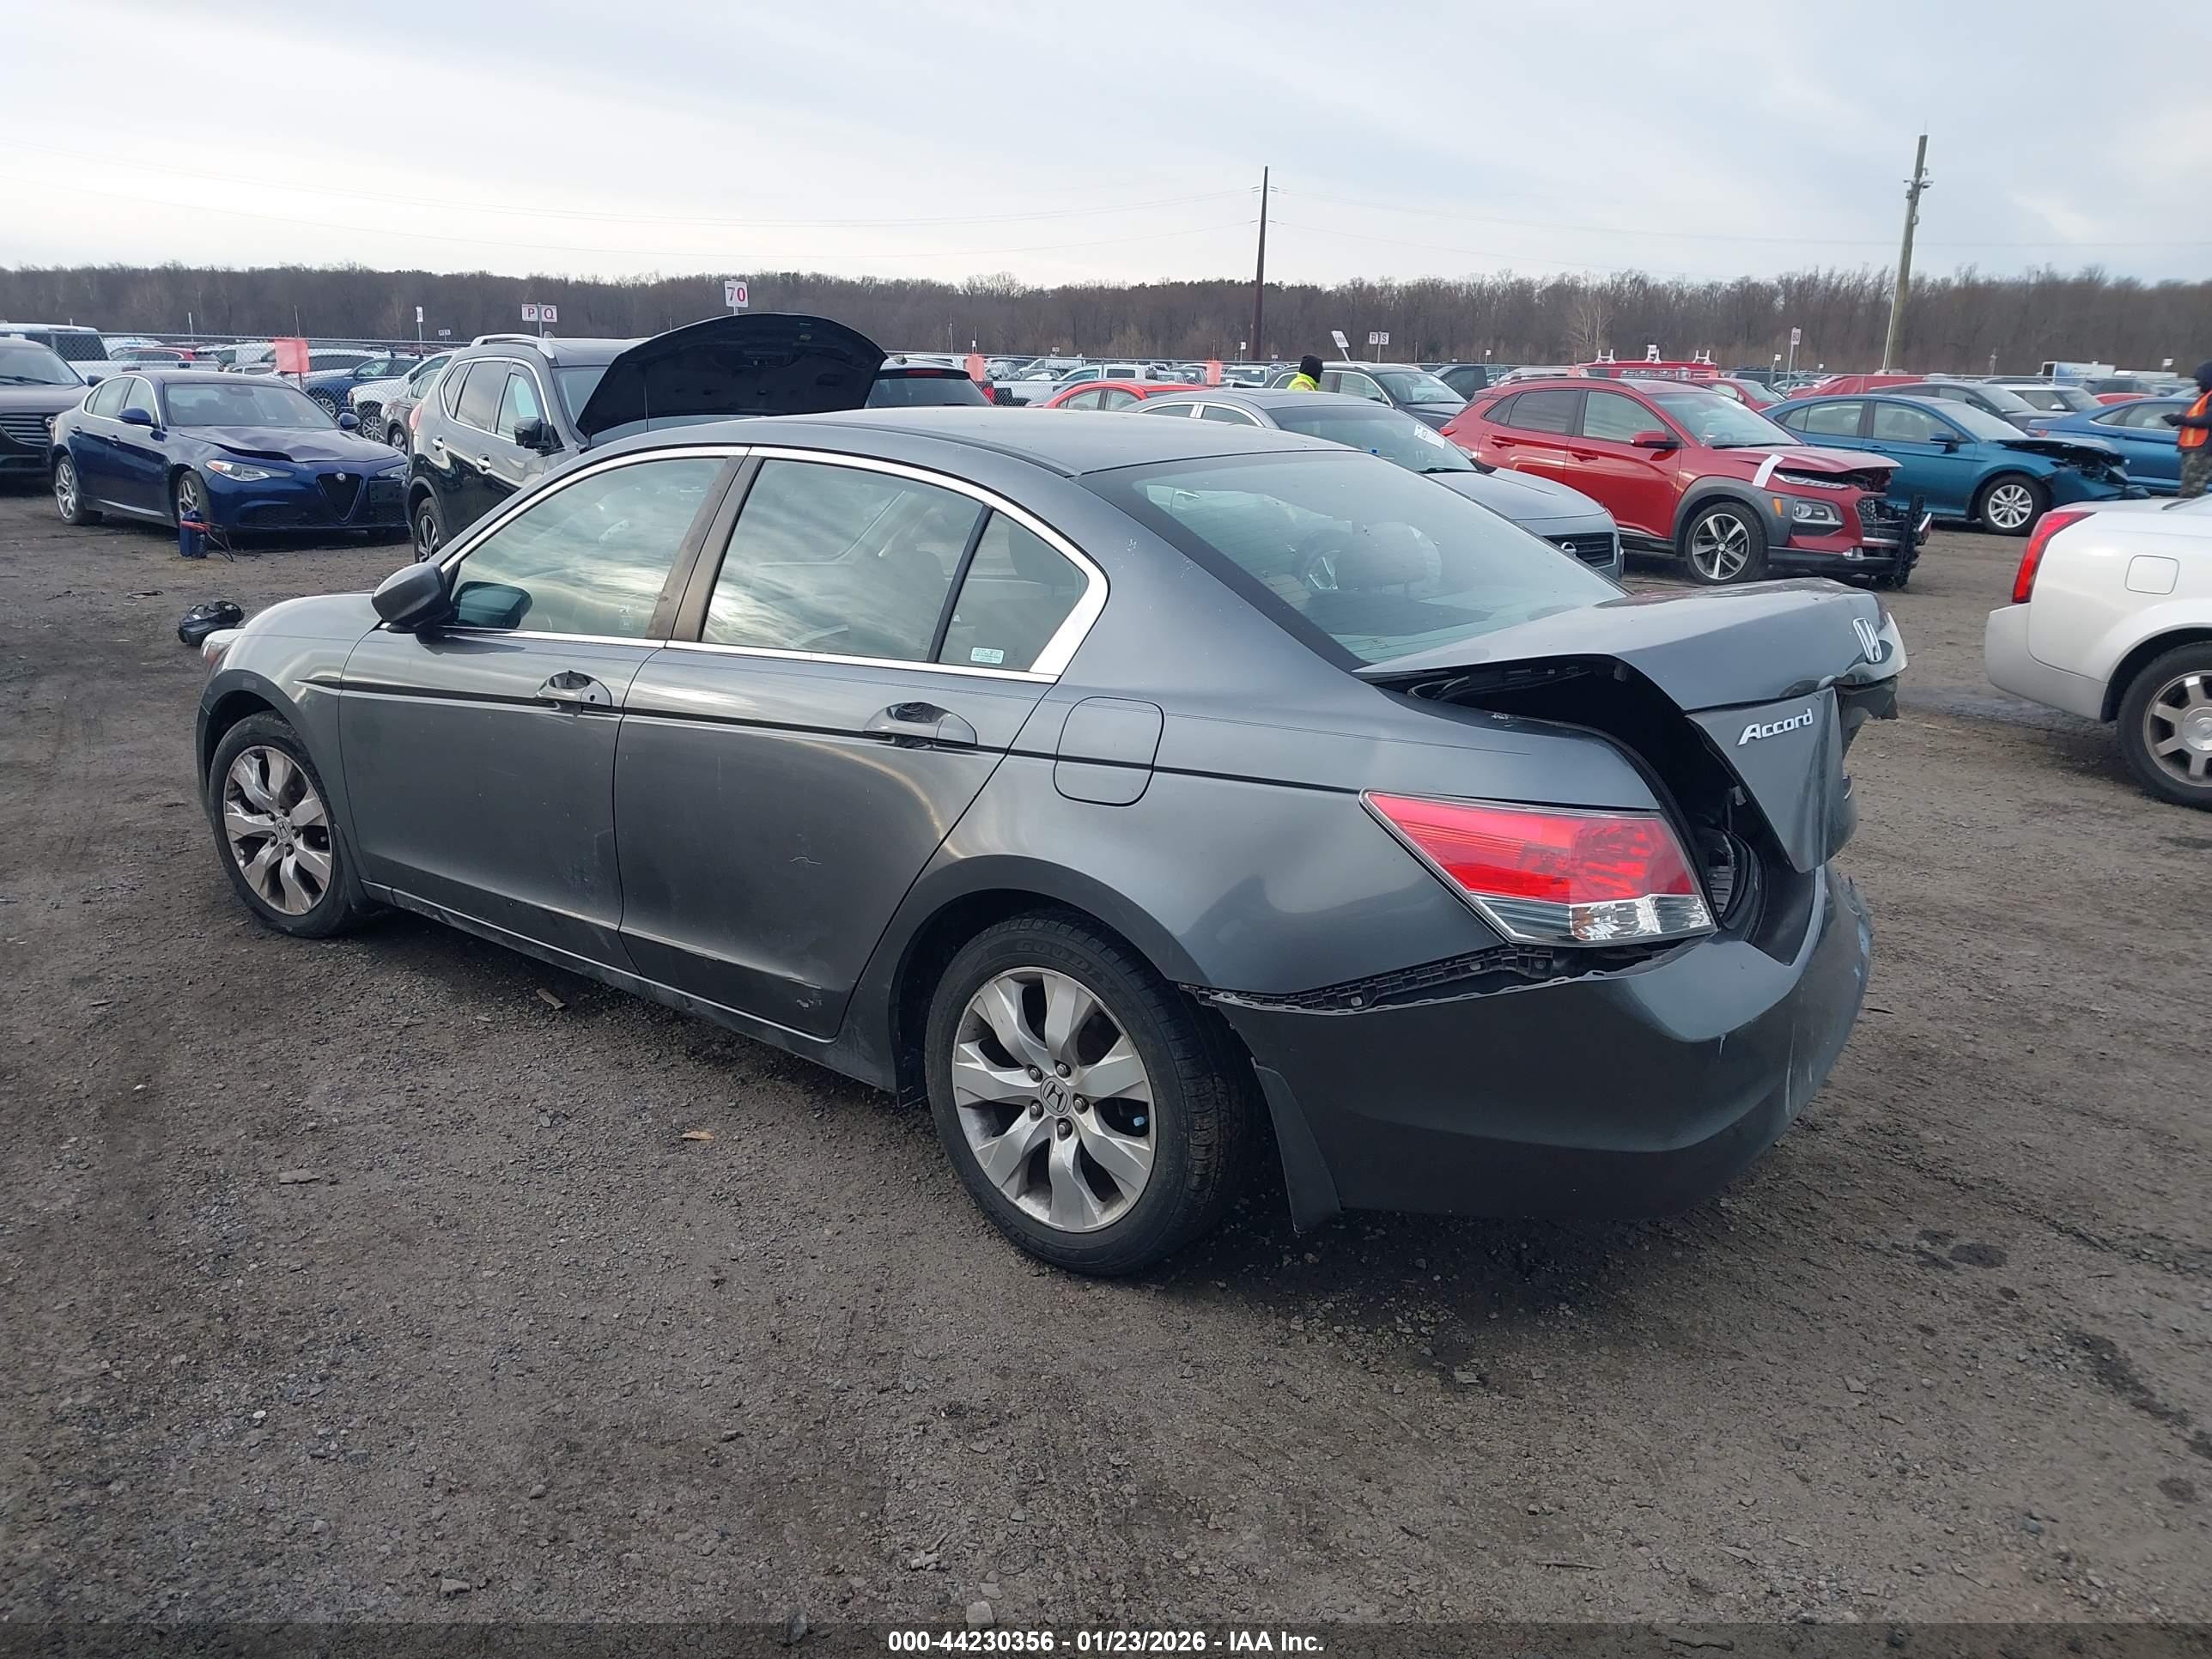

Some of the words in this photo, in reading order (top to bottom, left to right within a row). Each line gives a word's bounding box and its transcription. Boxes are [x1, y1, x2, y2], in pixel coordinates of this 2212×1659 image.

[726, 287, 746, 302] 70
[527, 307, 535, 319] P
[544, 307, 556, 319] Q
[1370, 333, 1377, 343] R
[1381, 333, 1388, 343] S
[1737, 708, 1814, 746] Accord
